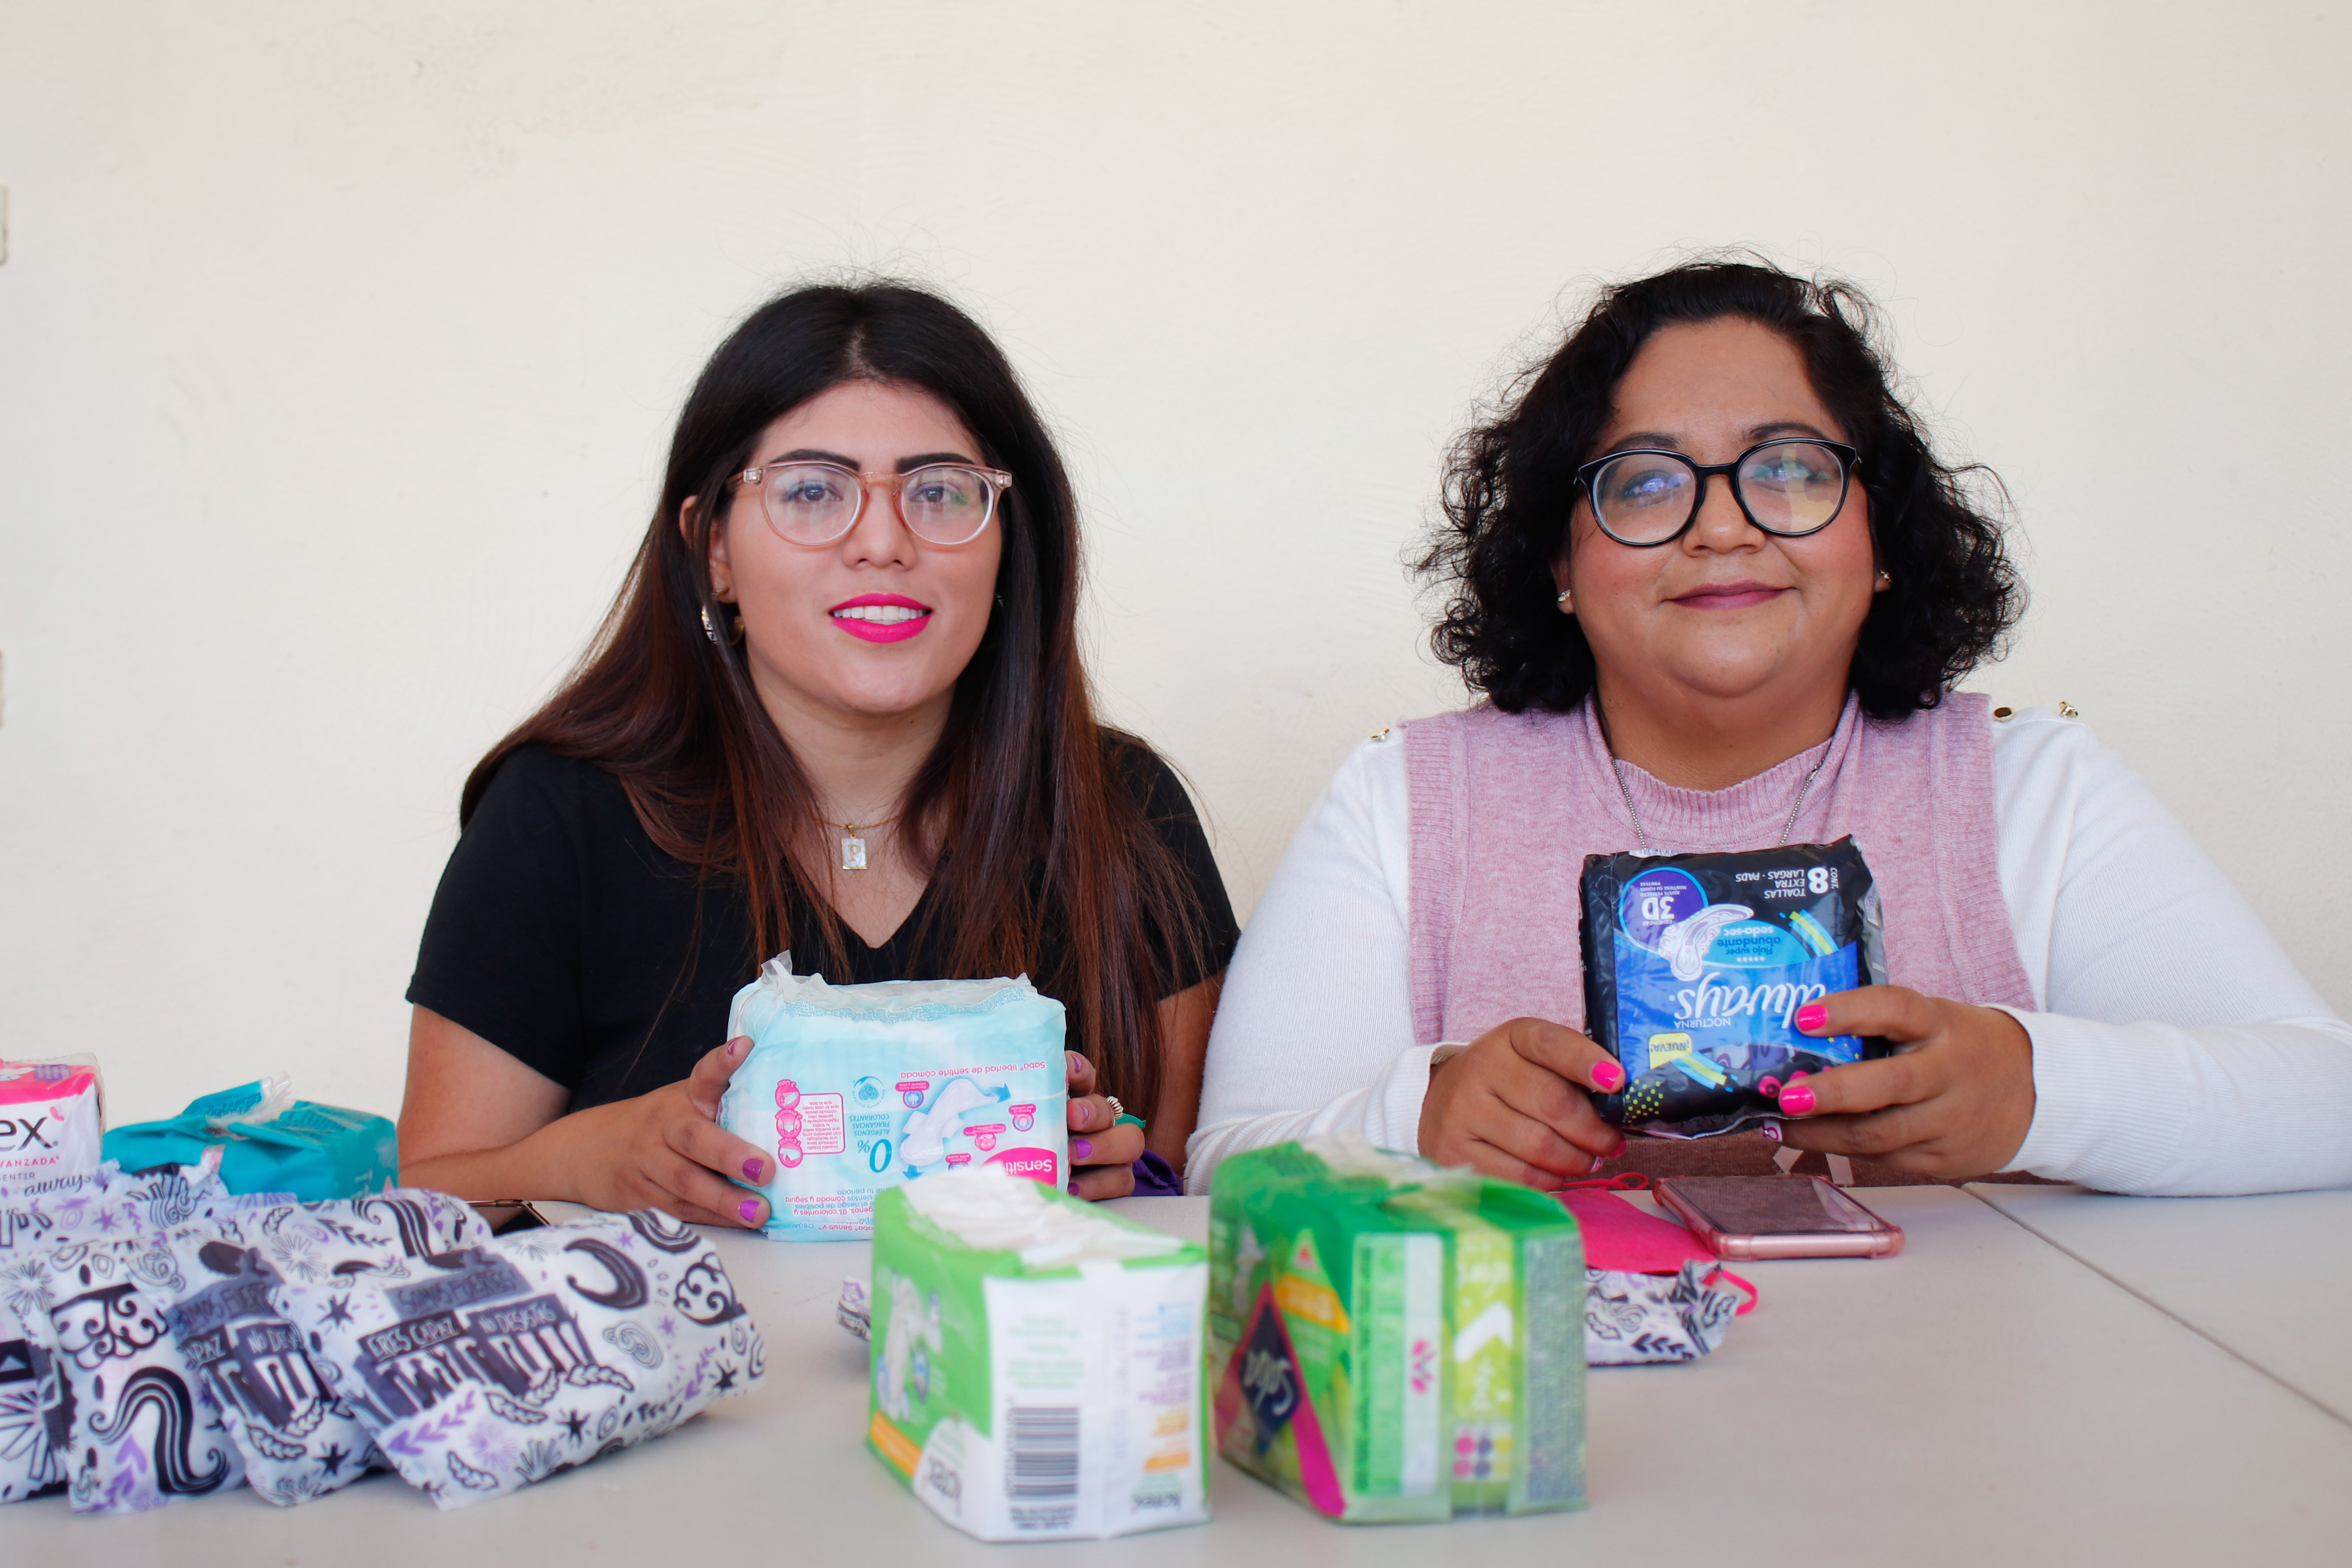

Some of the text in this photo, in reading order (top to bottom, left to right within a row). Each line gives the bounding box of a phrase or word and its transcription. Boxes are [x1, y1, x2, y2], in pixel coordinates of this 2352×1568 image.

[848, 844, 861, 862] P
[1735, 869, 1804, 882] LARGAS PADS
[1807, 867, 1829, 894] 8
[1830, 867, 1839, 889] CONT.
[1774, 878, 1805, 888] EXTRA
[1764, 888, 1806, 899] TOALLAS
[1642, 896, 1675, 920] 3D
[1723, 926, 1774, 937] seda-sec
[1717, 937, 1781, 948] abundante
[1725, 946, 1773, 955] Flujo super
[1673, 1017, 1731, 1029] NOCTURNA
[1650, 1040, 1690, 1053] ¡NUEVA!
[938, 1068, 969, 1077] sentirte
[985, 1064, 1017, 1073] libertad
[898, 1070, 936, 1080] cómoda.
[0, 1172, 35, 1182] ENTIR
